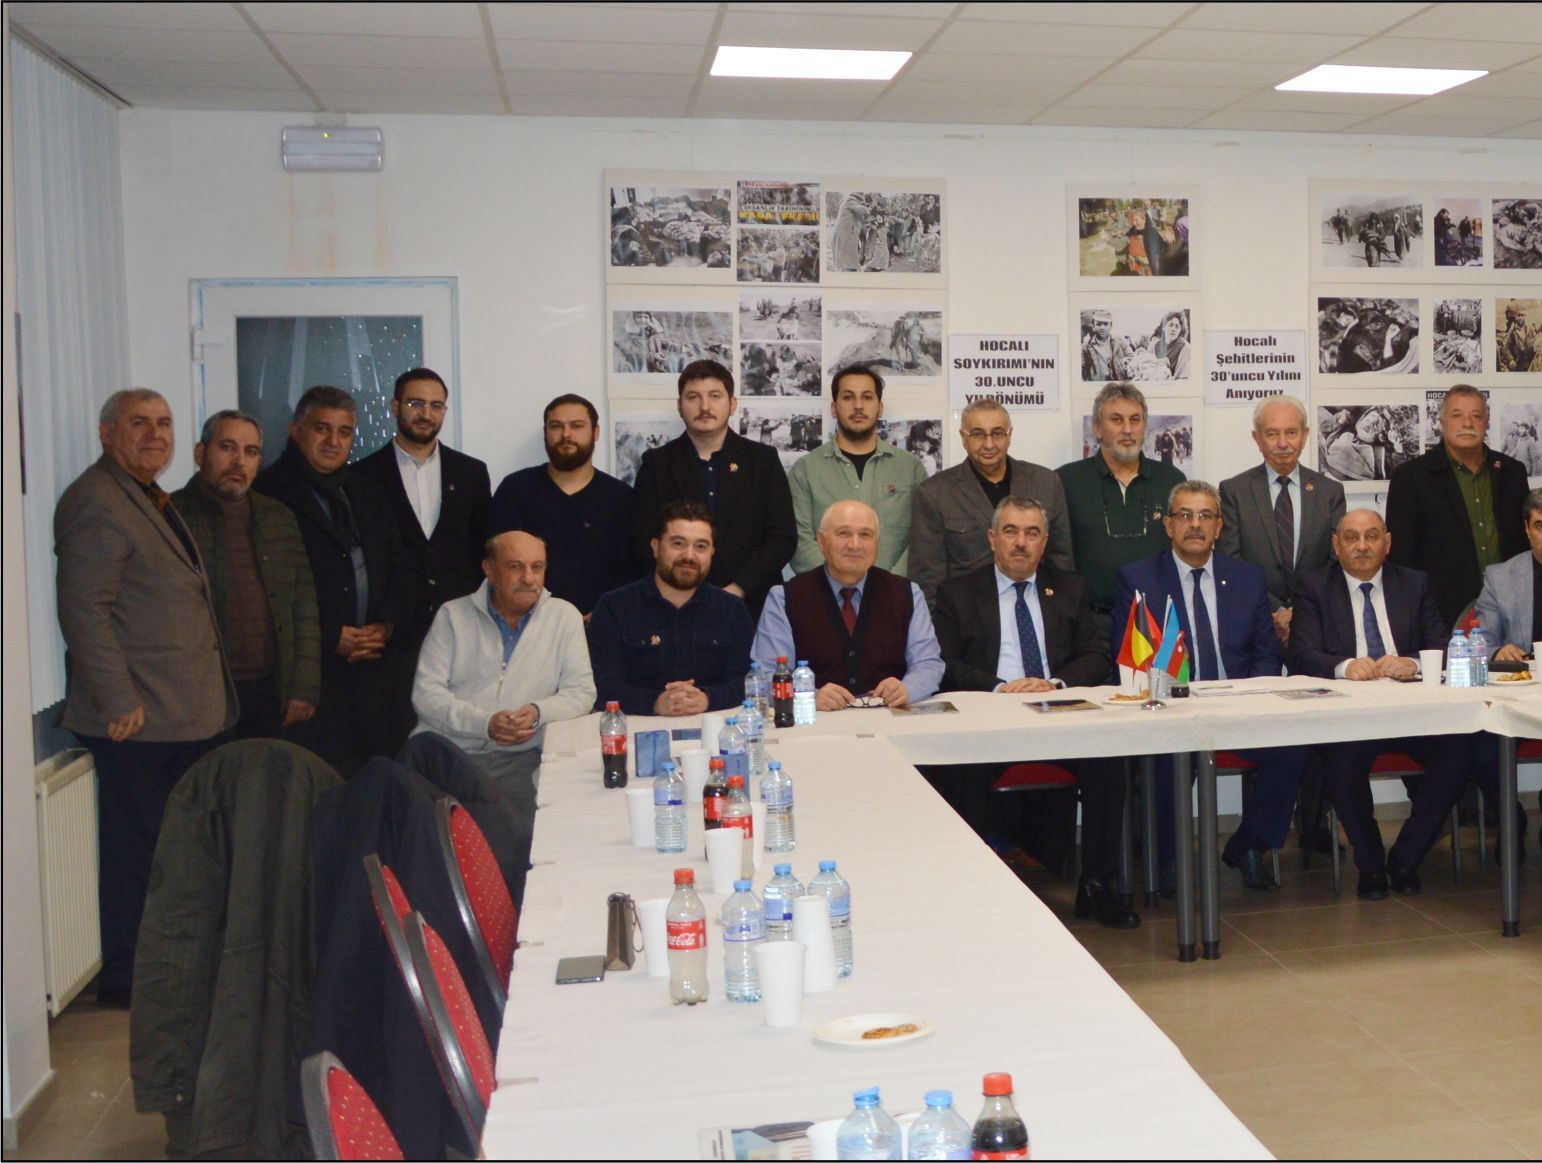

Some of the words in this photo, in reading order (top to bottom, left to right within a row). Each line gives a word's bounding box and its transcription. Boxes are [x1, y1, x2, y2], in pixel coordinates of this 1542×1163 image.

[979, 340, 1029, 351] HOCALI
[1234, 336, 1277, 346] Hocalı
[953, 358, 1055, 369] SOYKIRIMI'NIN
[1216, 353, 1295, 367] Şehitlerinin
[974, 376, 1034, 387] 30.UNCU
[1210, 370, 1265, 382] 30'uncu
[1268, 370, 1301, 381] Yılını
